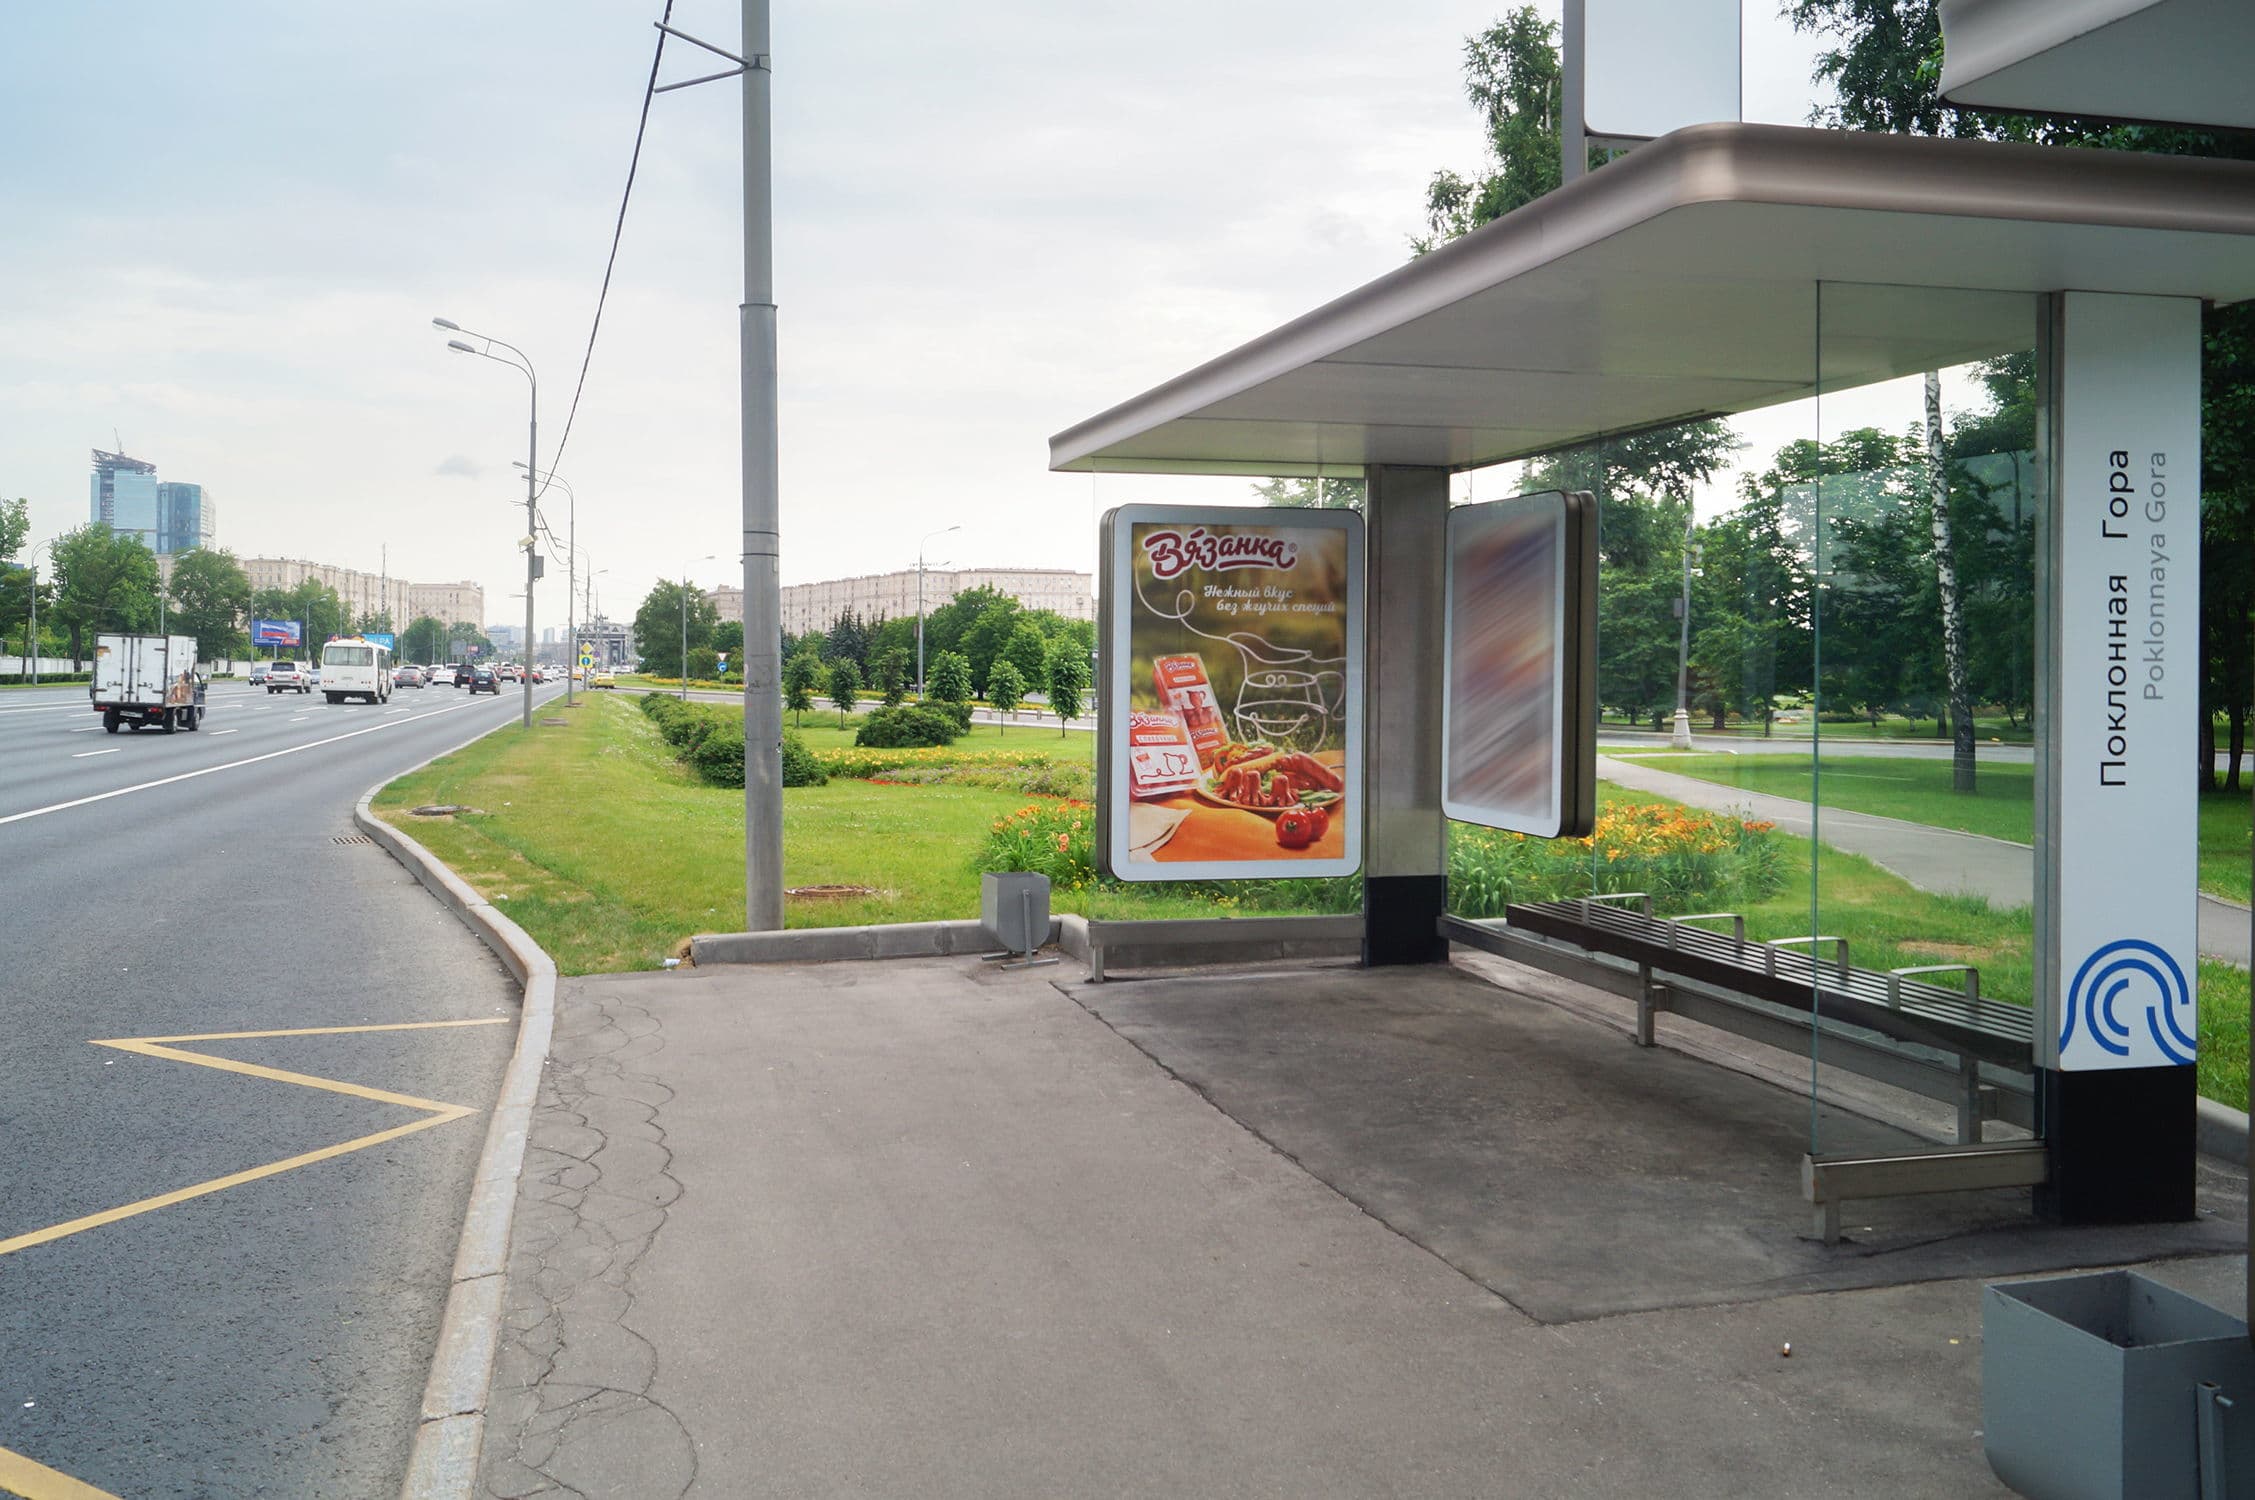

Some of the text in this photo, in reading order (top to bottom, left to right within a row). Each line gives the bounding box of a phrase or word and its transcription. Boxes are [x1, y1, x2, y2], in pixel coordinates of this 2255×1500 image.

[1203, 585, 1294, 603] Нежный вкус
[1216, 599, 1337, 616] без жгучих специй
[2099, 449, 2135, 787] Поклонная Гора
[2142, 451, 2170, 700] Poklonnaya Gora
